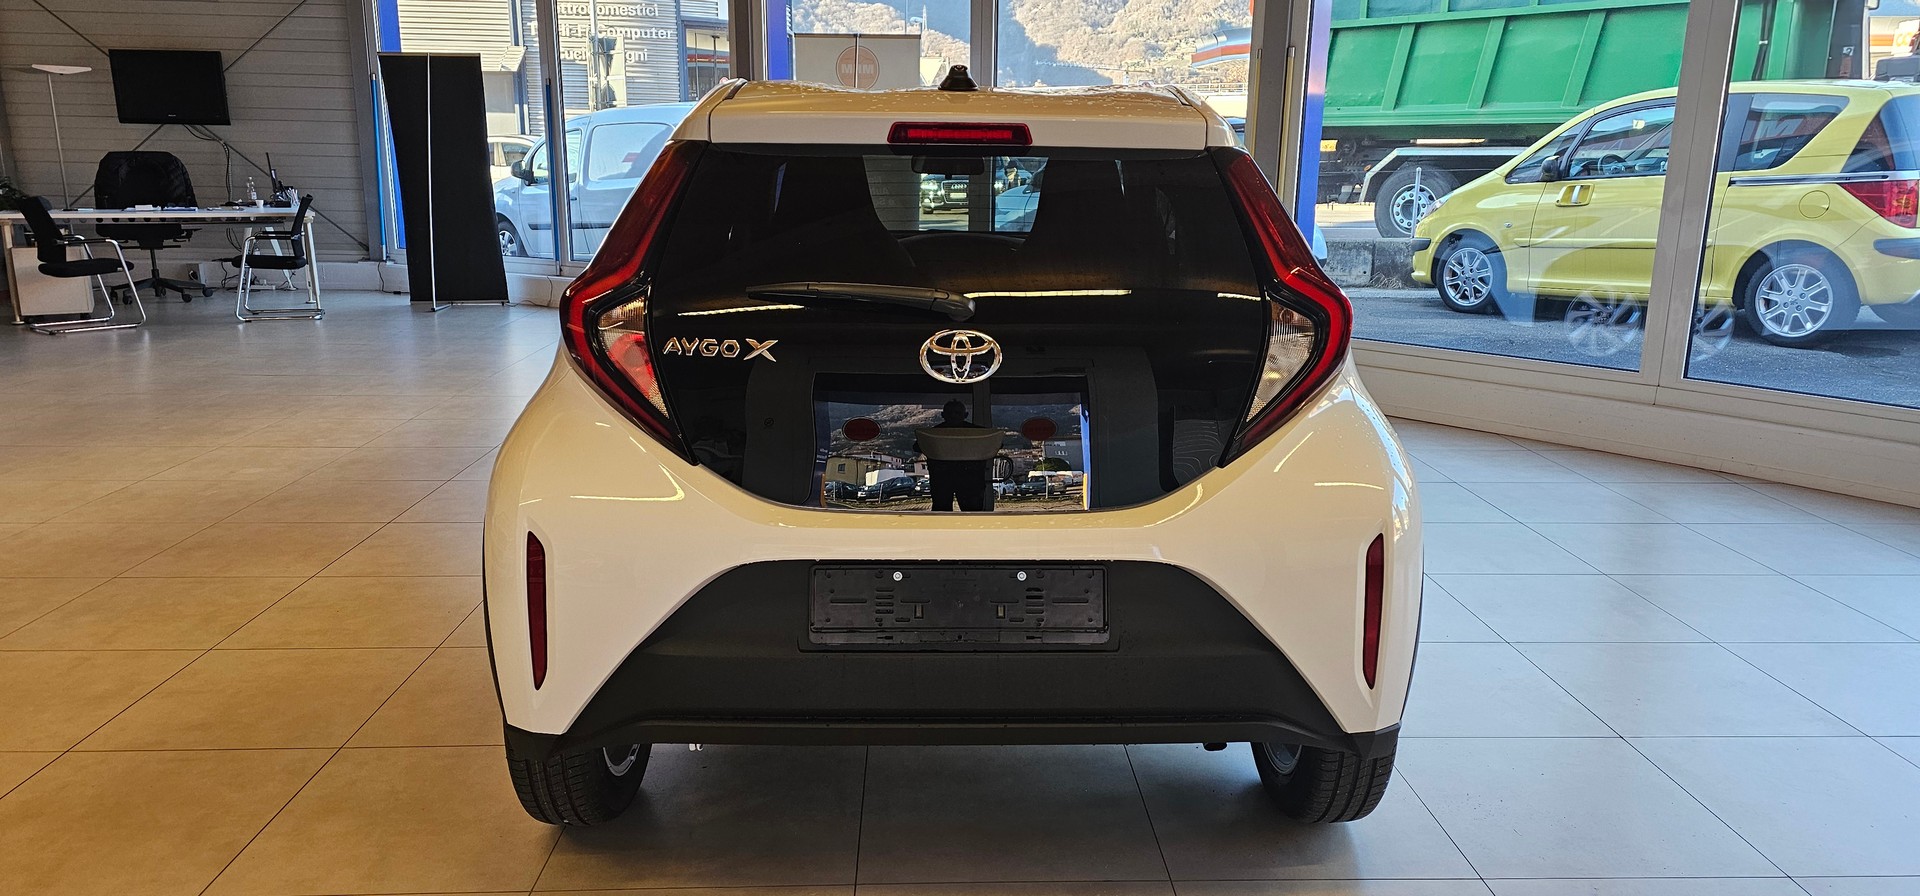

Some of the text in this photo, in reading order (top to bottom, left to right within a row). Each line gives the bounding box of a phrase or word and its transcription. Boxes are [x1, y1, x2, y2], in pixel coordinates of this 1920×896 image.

[597, 23, 673, 41] Computer
[661, 336, 779, 362] AYGO X
